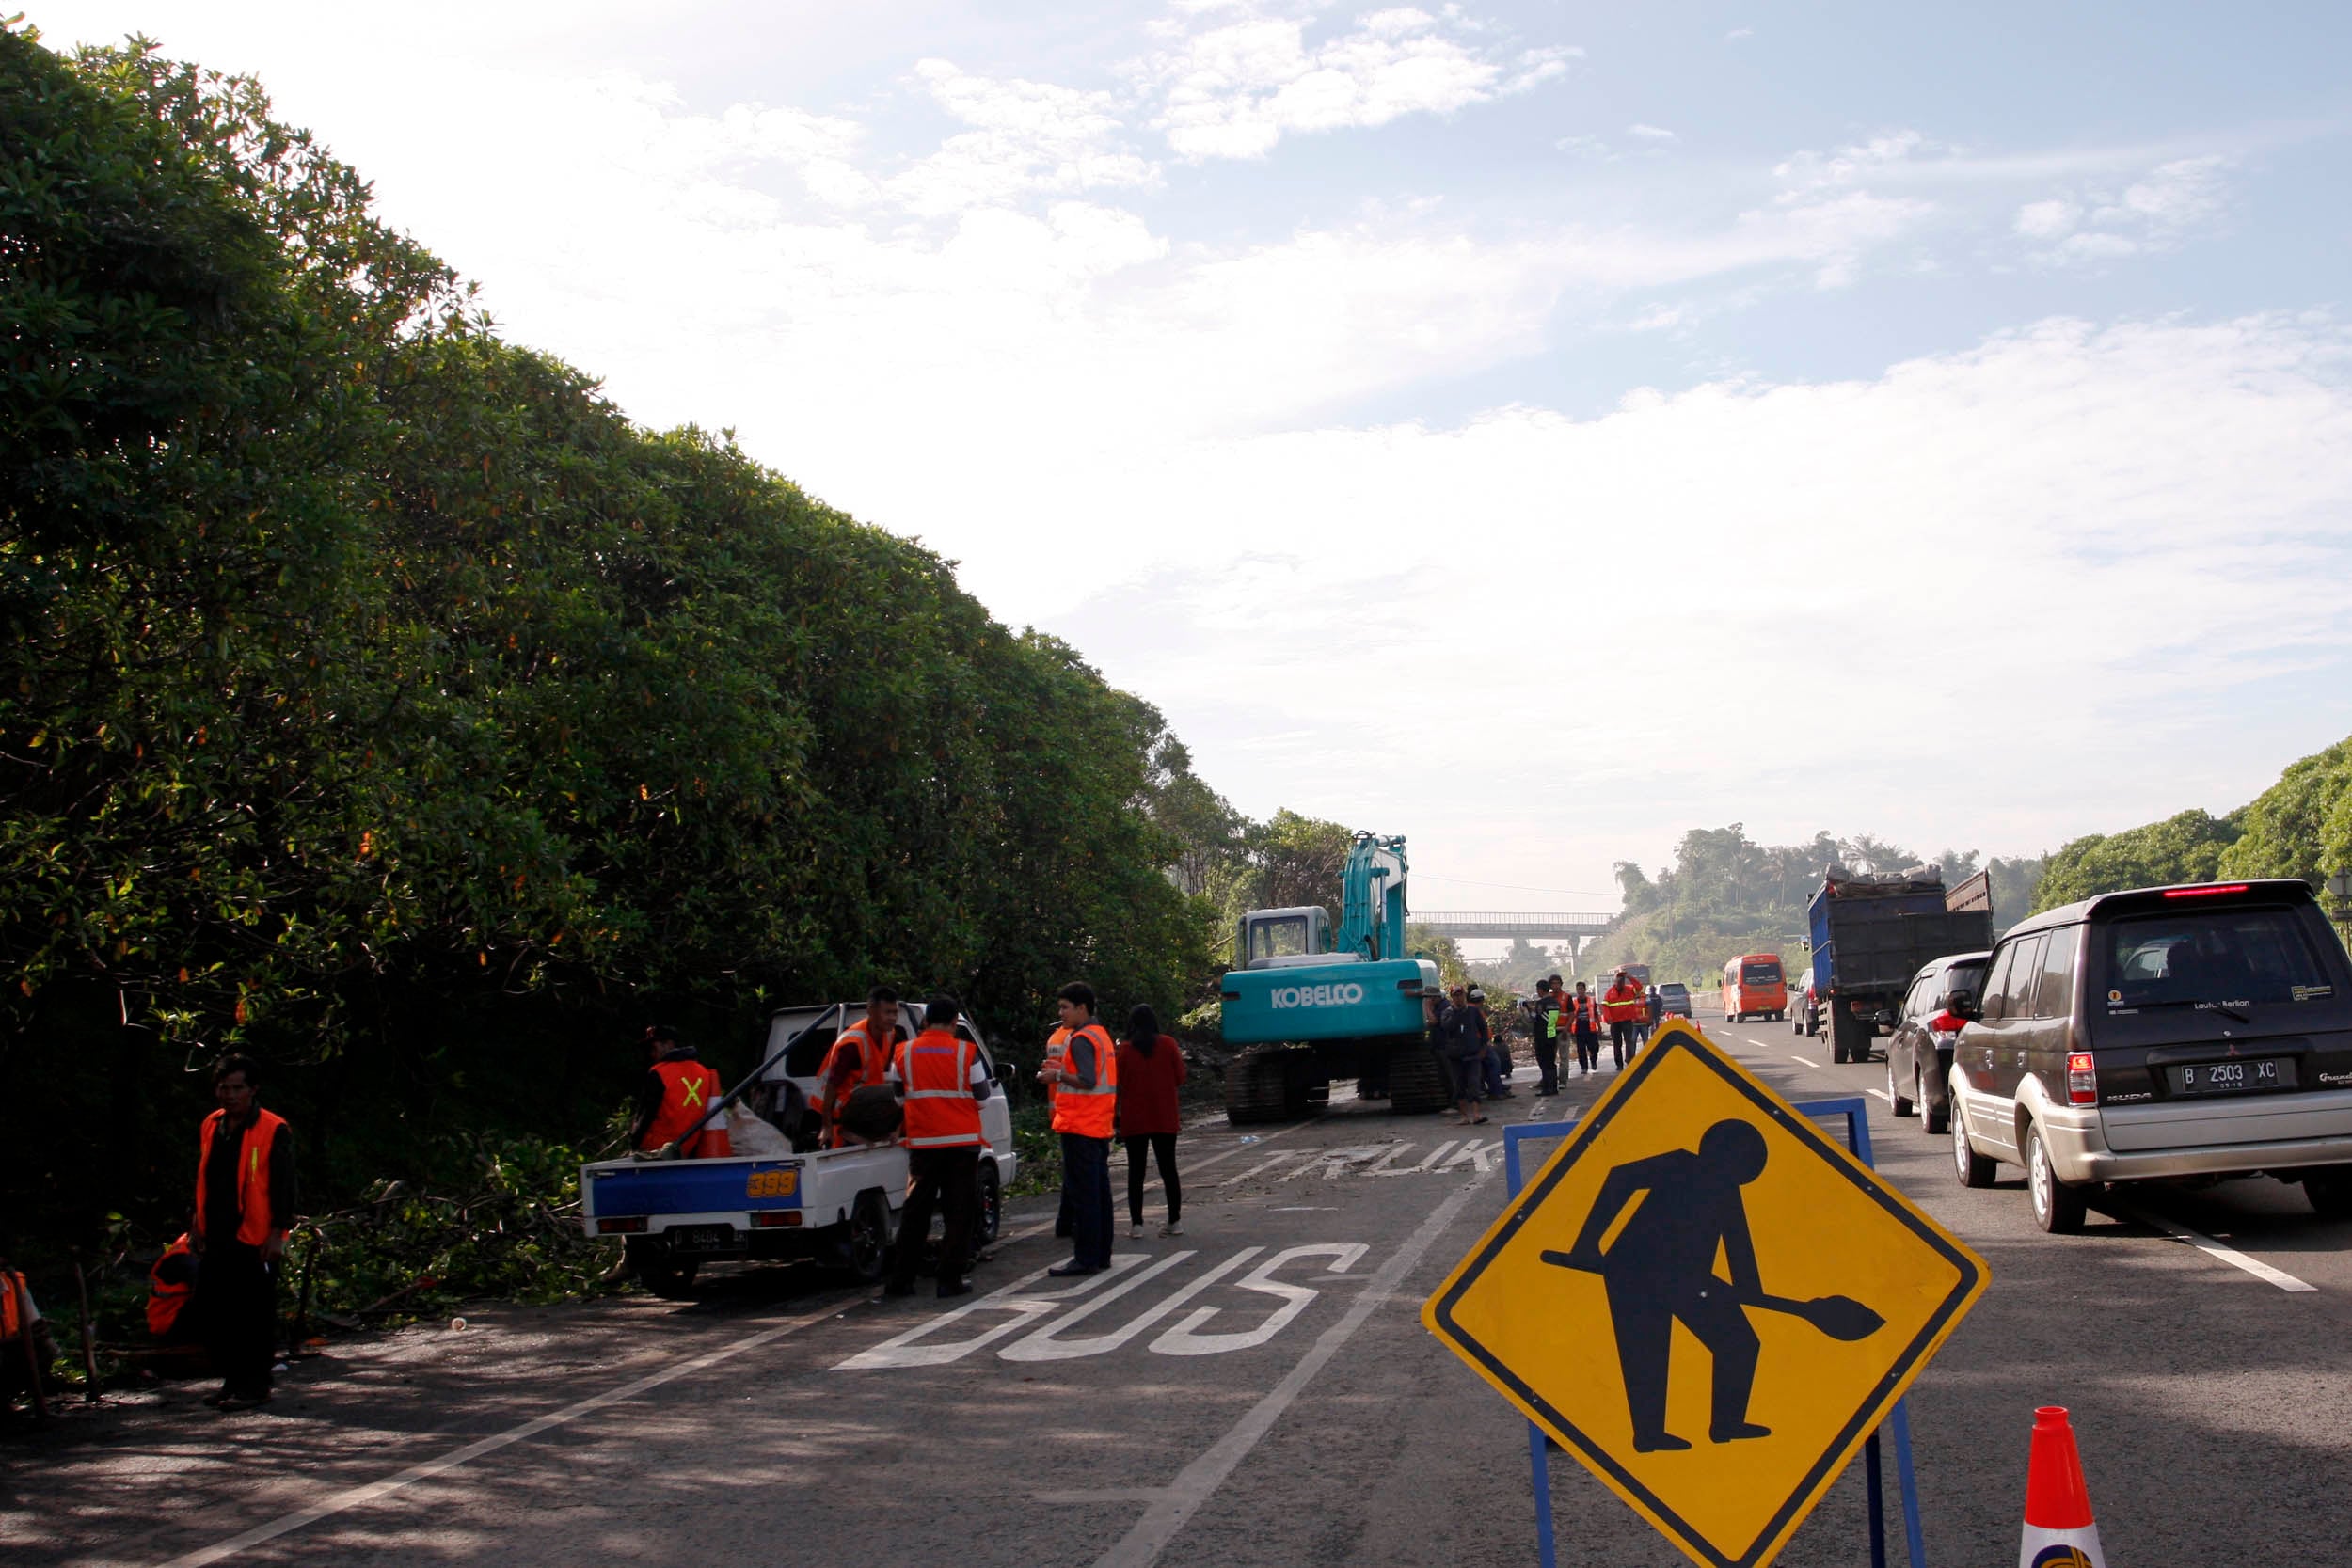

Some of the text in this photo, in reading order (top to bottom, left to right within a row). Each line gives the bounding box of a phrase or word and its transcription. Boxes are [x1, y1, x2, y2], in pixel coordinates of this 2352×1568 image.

[1271, 983, 1363, 1009] KOBELCO
[2185, 1063, 2275, 1084] B 2503 XC
[1218, 1139, 1504, 1186] TRUK
[747, 1170, 798, 1198] 399
[829, 1243, 1370, 1370] BUS
